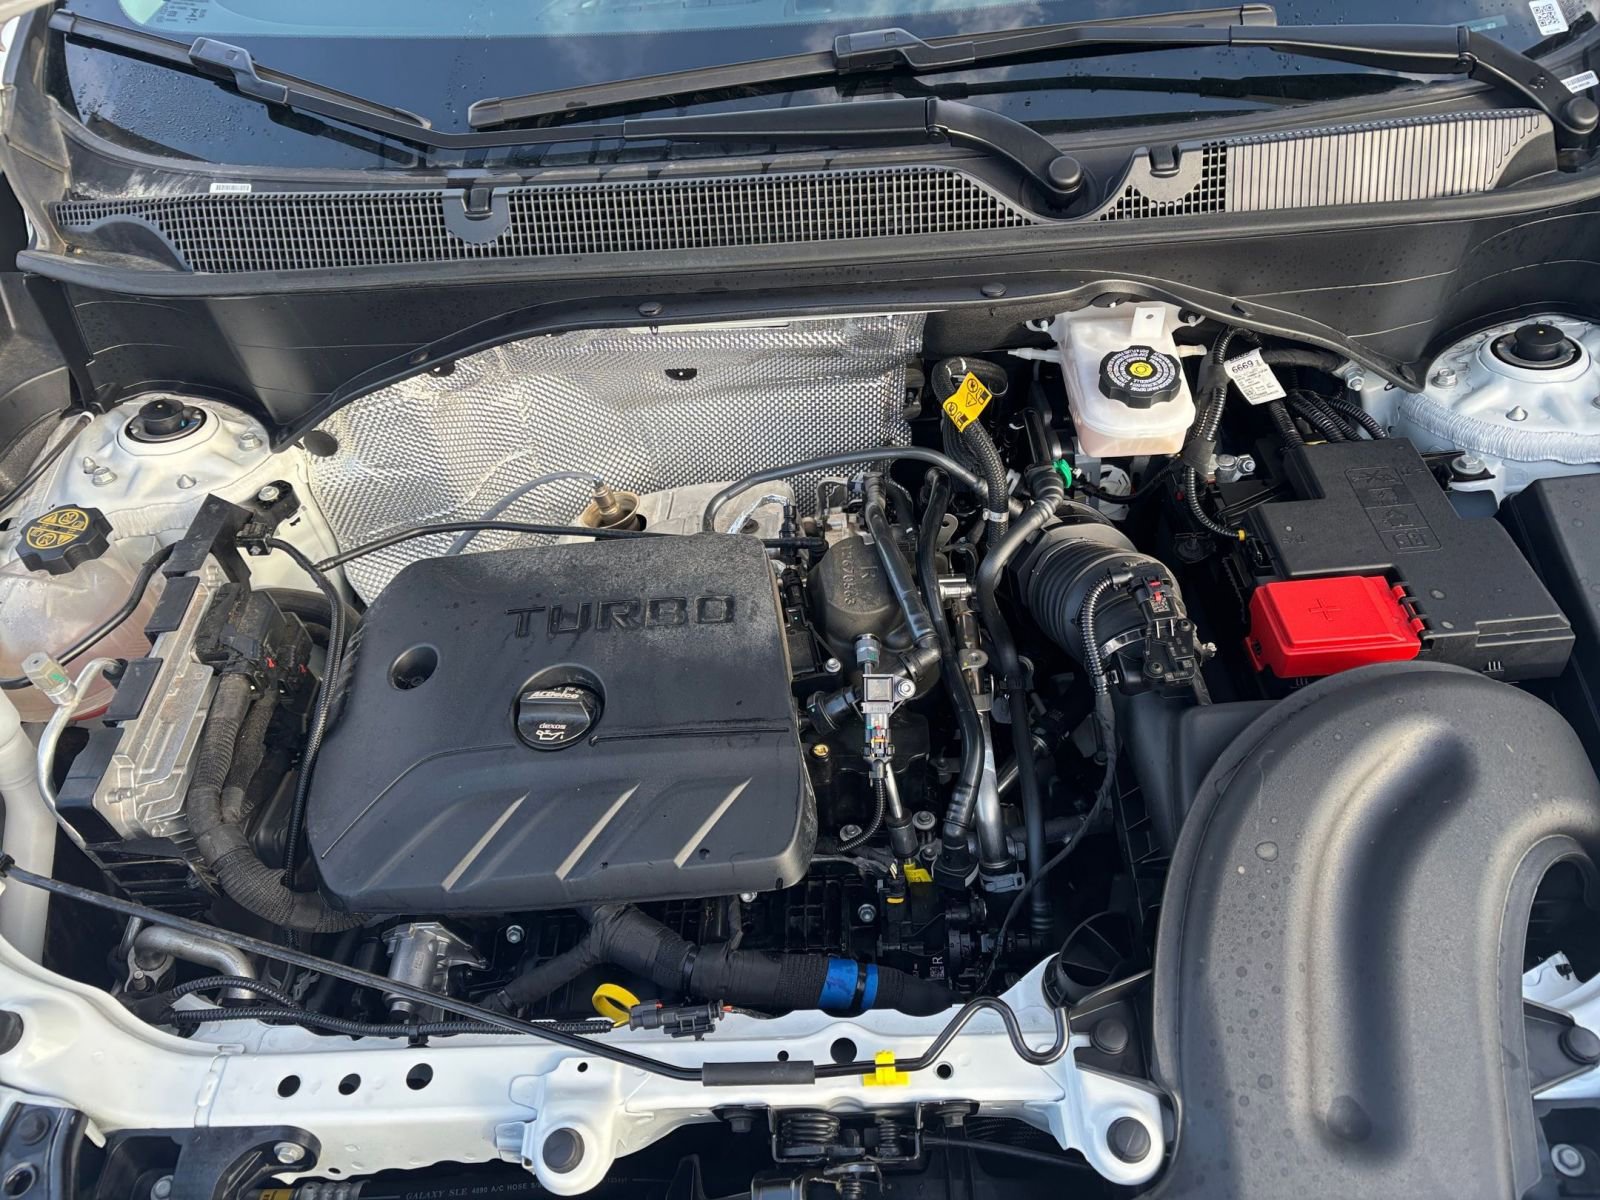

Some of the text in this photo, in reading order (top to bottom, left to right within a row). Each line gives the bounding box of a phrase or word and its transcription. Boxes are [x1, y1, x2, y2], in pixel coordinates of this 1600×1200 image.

[1231, 360, 1254, 374] 6669
[503, 594, 735, 639] TURBO
[539, 722, 567, 730] dexos
[405, 1190, 446, 1200] GALAXY
[448, 1187, 469, 1197] SLE
[491, 1184, 504, 1193] A/C
[507, 1182, 527, 1191] HOSE
